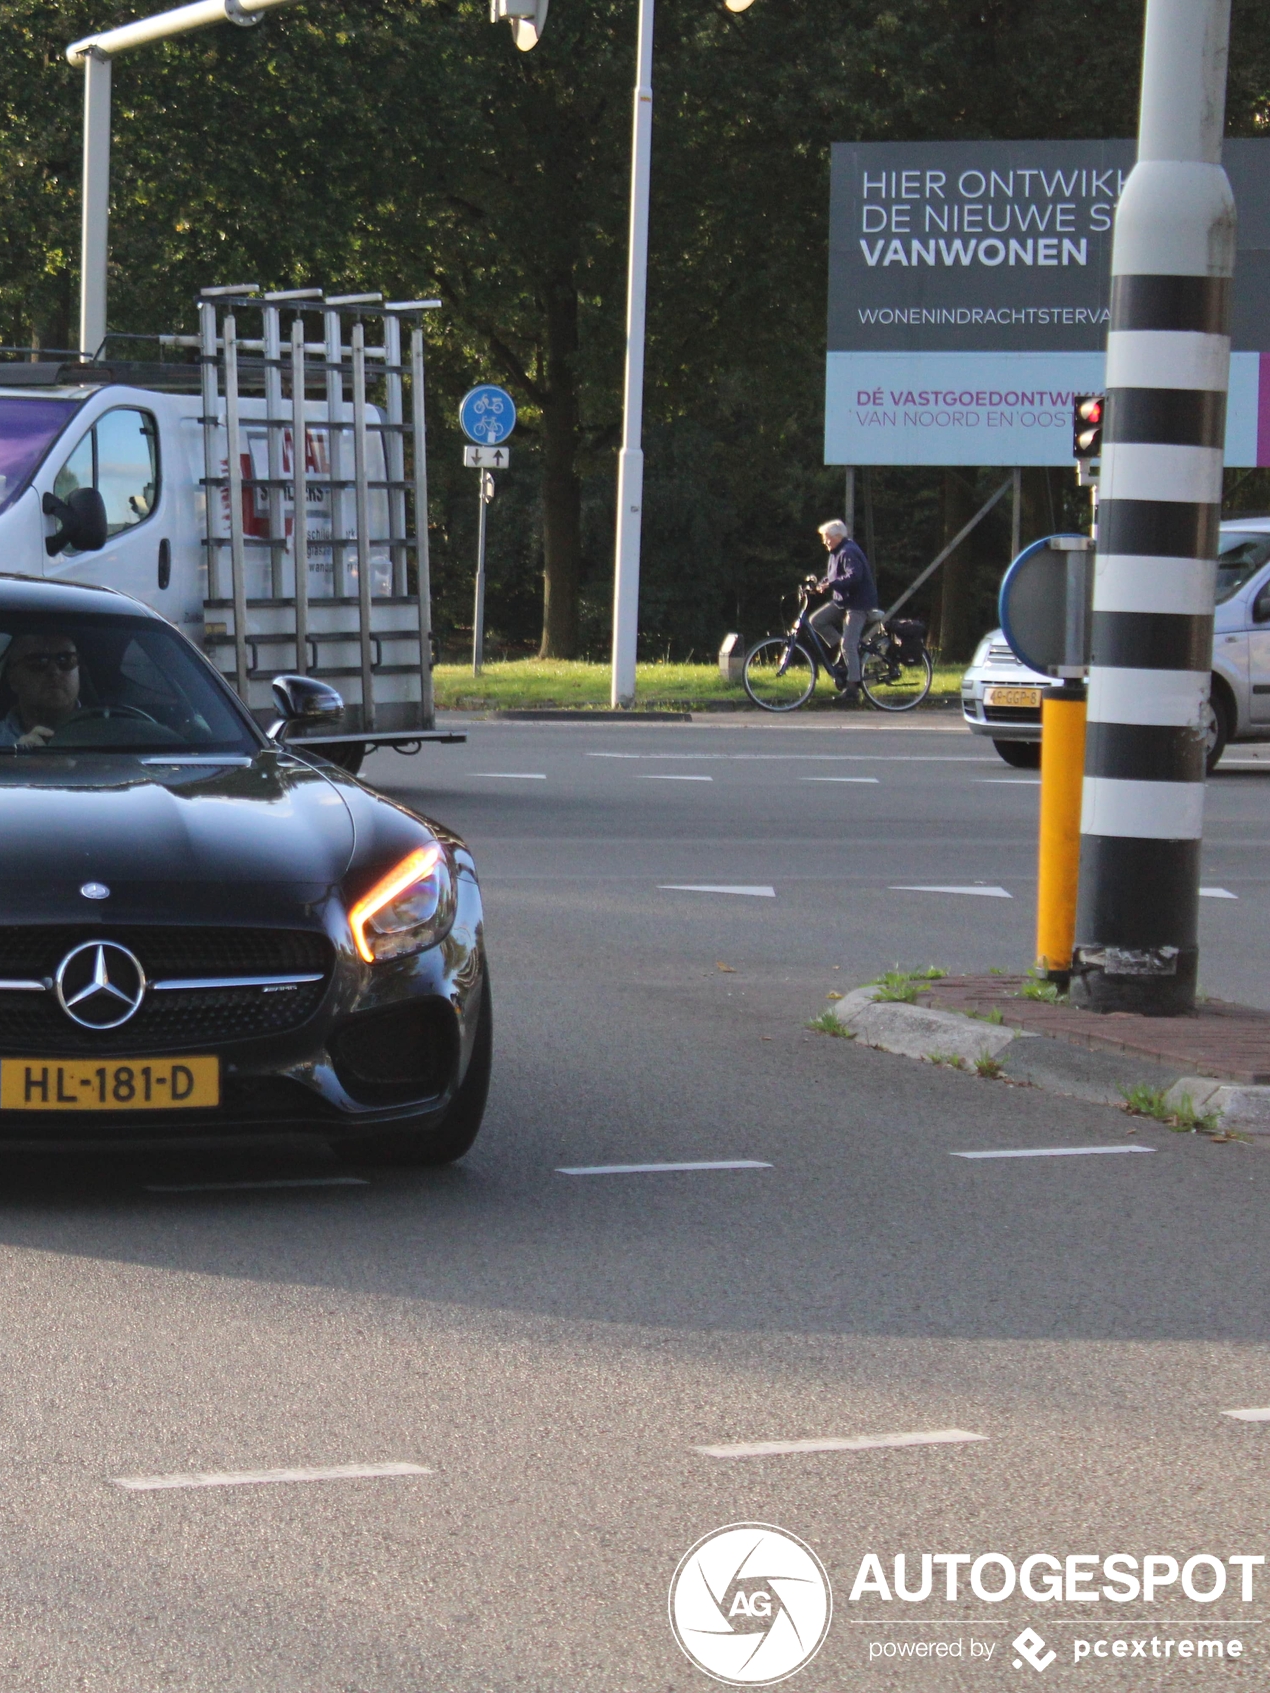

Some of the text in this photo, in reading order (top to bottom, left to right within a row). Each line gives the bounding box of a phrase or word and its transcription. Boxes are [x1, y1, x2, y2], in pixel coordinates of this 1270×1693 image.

[863, 170, 946, 199] HIER
[862, 203, 1117, 233] DE NIEUWE S
[859, 238, 1087, 266] VANWONEN
[858, 308, 1110, 324] WONENINDRACHTSTERVA
[856, 387, 1104, 407] DÉ VASTGOEDONTWI
[856, 411, 896, 427] VAN
[903, 411, 980, 427] NOORD
[987, 411, 1013, 427] EN
[24, 1065, 195, 1103] HL-181-D
